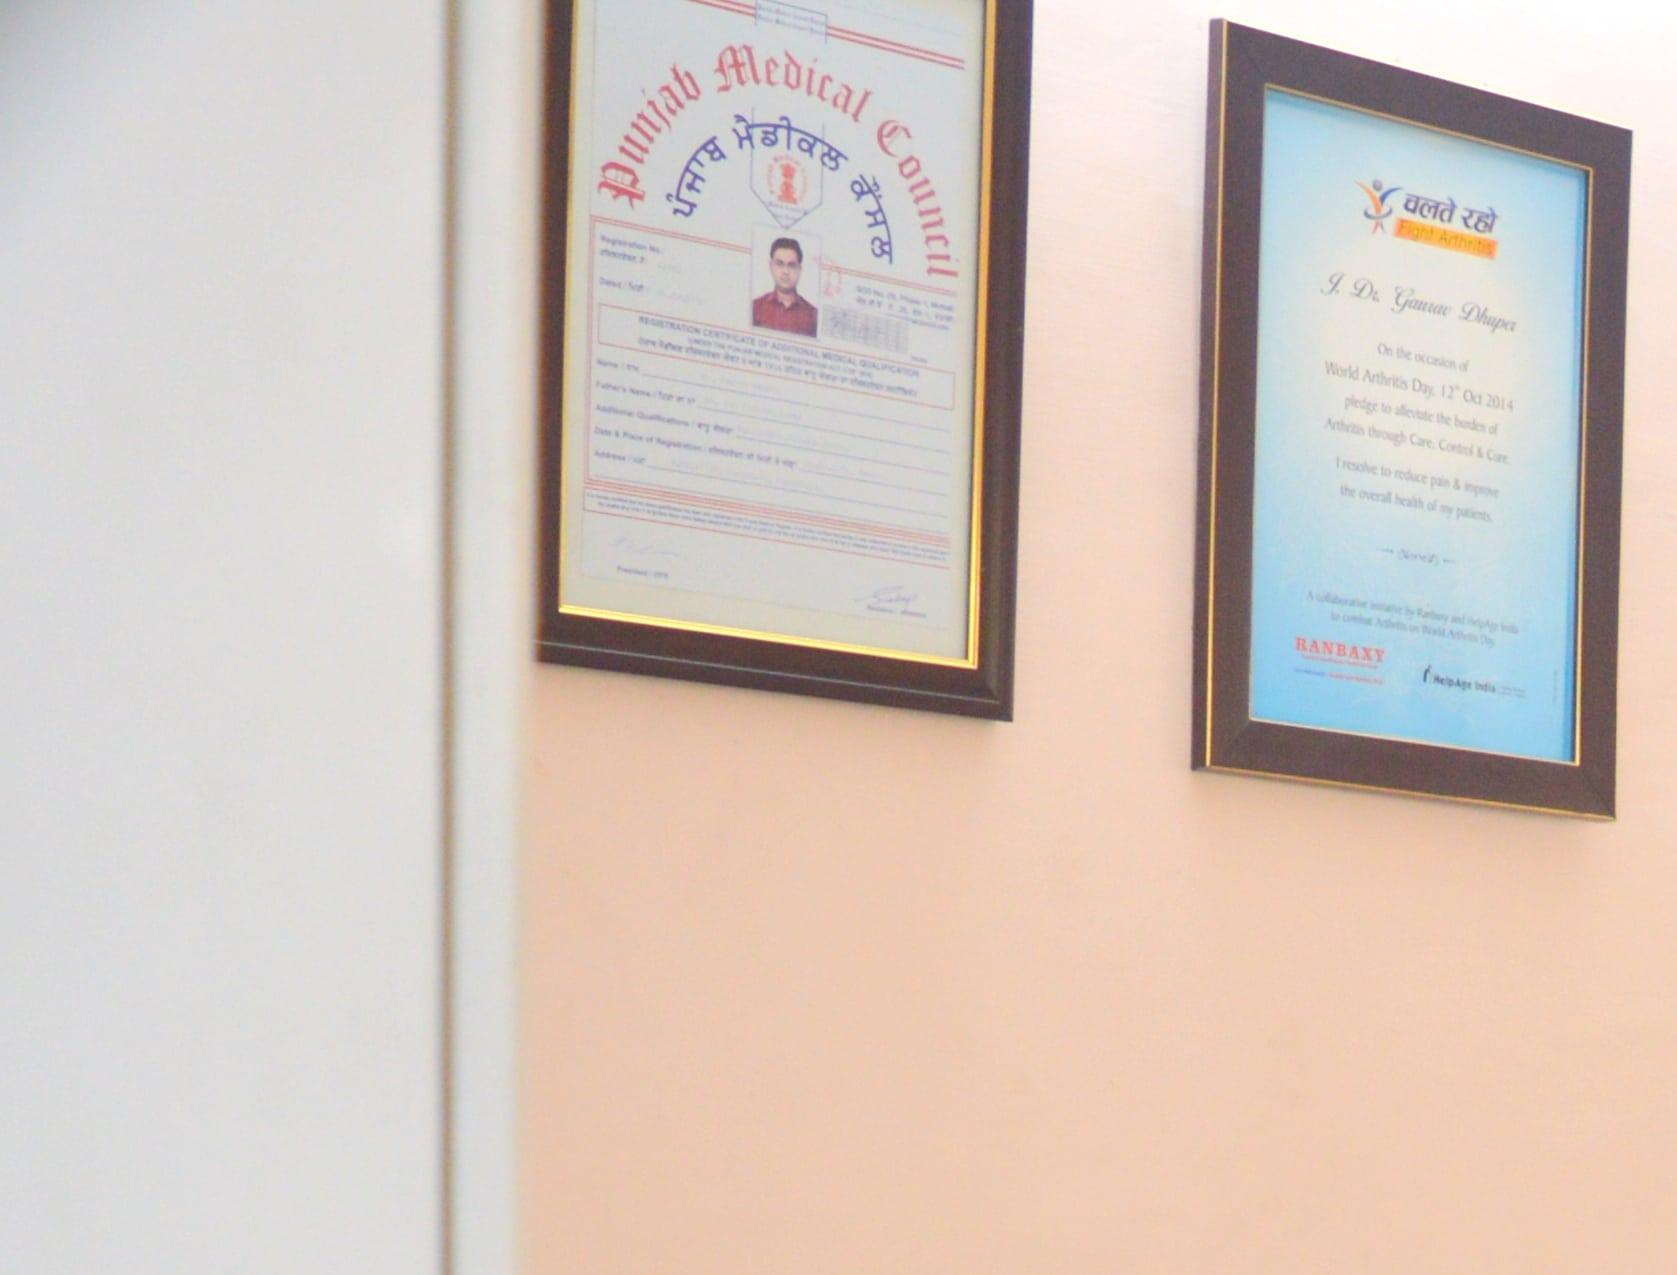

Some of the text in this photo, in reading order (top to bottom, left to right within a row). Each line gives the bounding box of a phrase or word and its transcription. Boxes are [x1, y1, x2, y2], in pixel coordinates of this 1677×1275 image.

[597, 43, 960, 279] Punjab Medical Council
[665, 136, 727, 218] ਪੰਜਾਬ
[1403, 193, 1498, 233] चलते रहो
[1400, 222, 1494, 256] Fight Arthritis
[1377, 342, 1470, 373] On the occasion of
[1324, 360, 1360, 381] World
[1362, 369, 1409, 391] Arthritis
[1463, 389, 1482, 405] Oct
[1485, 394, 1514, 412] 2014
[1344, 396, 1377, 415] pledge
[1381, 401, 1392, 413] to
[1436, 411, 1451, 426] the
[1454, 415, 1487, 433] burden
[1488, 423, 1499, 435] of
[1324, 417, 1366, 437] Arthritis
[1368, 425, 1406, 447] through
[1476, 446, 1484, 459] &
[1335, 456, 1340, 469] I
[1342, 459, 1377, 475] resolve
[1380, 466, 1392, 477] to
[1394, 468, 1428, 485] reduce
[1430, 475, 1450, 490] pain
[1453, 479, 1461, 490] &
[1340, 484, 1356, 498] the
[1359, 487, 1392, 504] overall
[1394, 493, 1425, 509] health
[1427, 500, 1438, 512] of
[1439, 504, 1453, 519] my
[1295, 637, 1385, 664] RANBAXY
[1433, 674, 1473, 691] HelpAge
[1475, 680, 1496, 694] India
